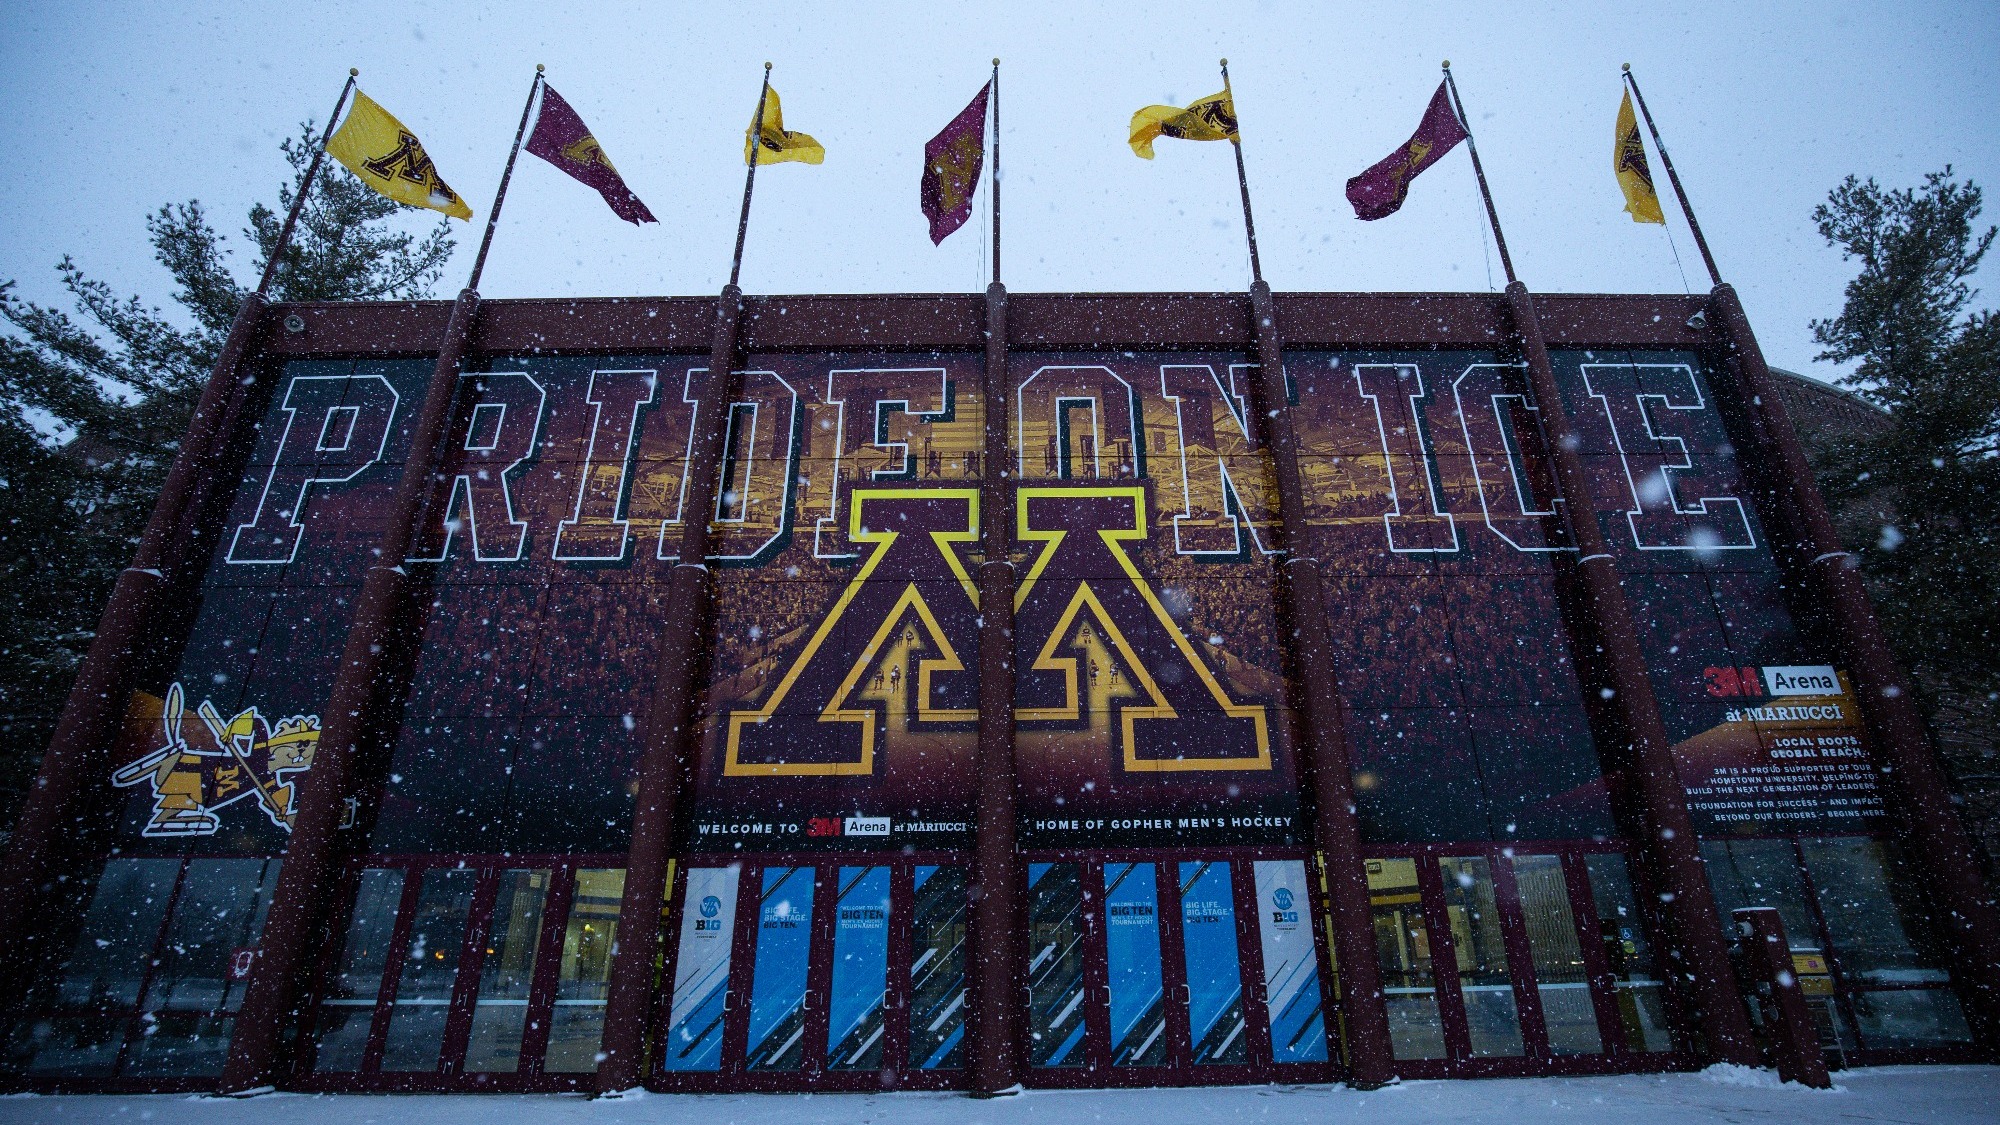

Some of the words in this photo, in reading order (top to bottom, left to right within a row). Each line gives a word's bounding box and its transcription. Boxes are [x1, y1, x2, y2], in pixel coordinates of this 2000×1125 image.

[225, 367, 953, 566] PRIDE
[1355, 362, 1757, 555] ICE
[723, 486, 1273, 777] M
[1703, 666, 1763, 698] 3M
[1775, 672, 1834, 690] Arena
[1725, 709, 1742, 722] at
[1745, 704, 1844, 722] MARIUCCI
[1775, 737, 1814, 748] LOCAL
[1817, 736, 1862, 746] ROOTS.
[1770, 749, 1818, 759] GLOBAL
[1750, 766, 1781, 774] PROUD
[1783, 764, 1835, 773] SUPPORTER
[1710, 776, 1762, 785] HOMETOWN
[1822, 773, 1862, 782] HELPING
[1686, 787, 1713, 795] BUILD
[1716, 786, 1734, 794] THE
[1762, 784, 1819, 793] GENERATION
[1695, 801, 1754, 810] FOUNDATION
[1756, 800, 1775, 808] FOR
[1777, 799, 1818, 808] SUCCESS
[1829, 798, 1848, 806] AND
[1851, 797, 1883, 805] IMPACT
[1714, 813, 1751, 821] BEYOND
[1754, 812, 1773, 820] OUR
[1775, 811, 1817, 820] BORDERS
[1827, 810, 1860, 818] BEGINS
[698, 823, 773, 835] WELCOME
[780, 823, 799, 834] TO
[806, 817, 841, 838] 3M
[849, 820, 886, 832] Arena
[894, 824, 905, 832] at
[906, 822, 967, 833] MARIUCCI
[1036, 819, 1079, 830] HOME
[1085, 819, 1105, 830] OF
[1111, 818, 1173, 830] GOPHER
[1179, 817, 1226, 829] MEN'S
[1231, 816, 1292, 828] HOCKEY
[1185, 901, 1200, 909] BIG
[1201, 901, 1221, 909] LIFE.
[841, 910, 861, 919] BIG
[862, 910, 884, 919] TEN
[1111, 906, 1130, 916] BIG
[1131, 906, 1153, 916] TEN
[1186, 908, 1201, 916] BIG
[764, 914, 778, 922] BIG
[763, 921, 778, 929] BIG
